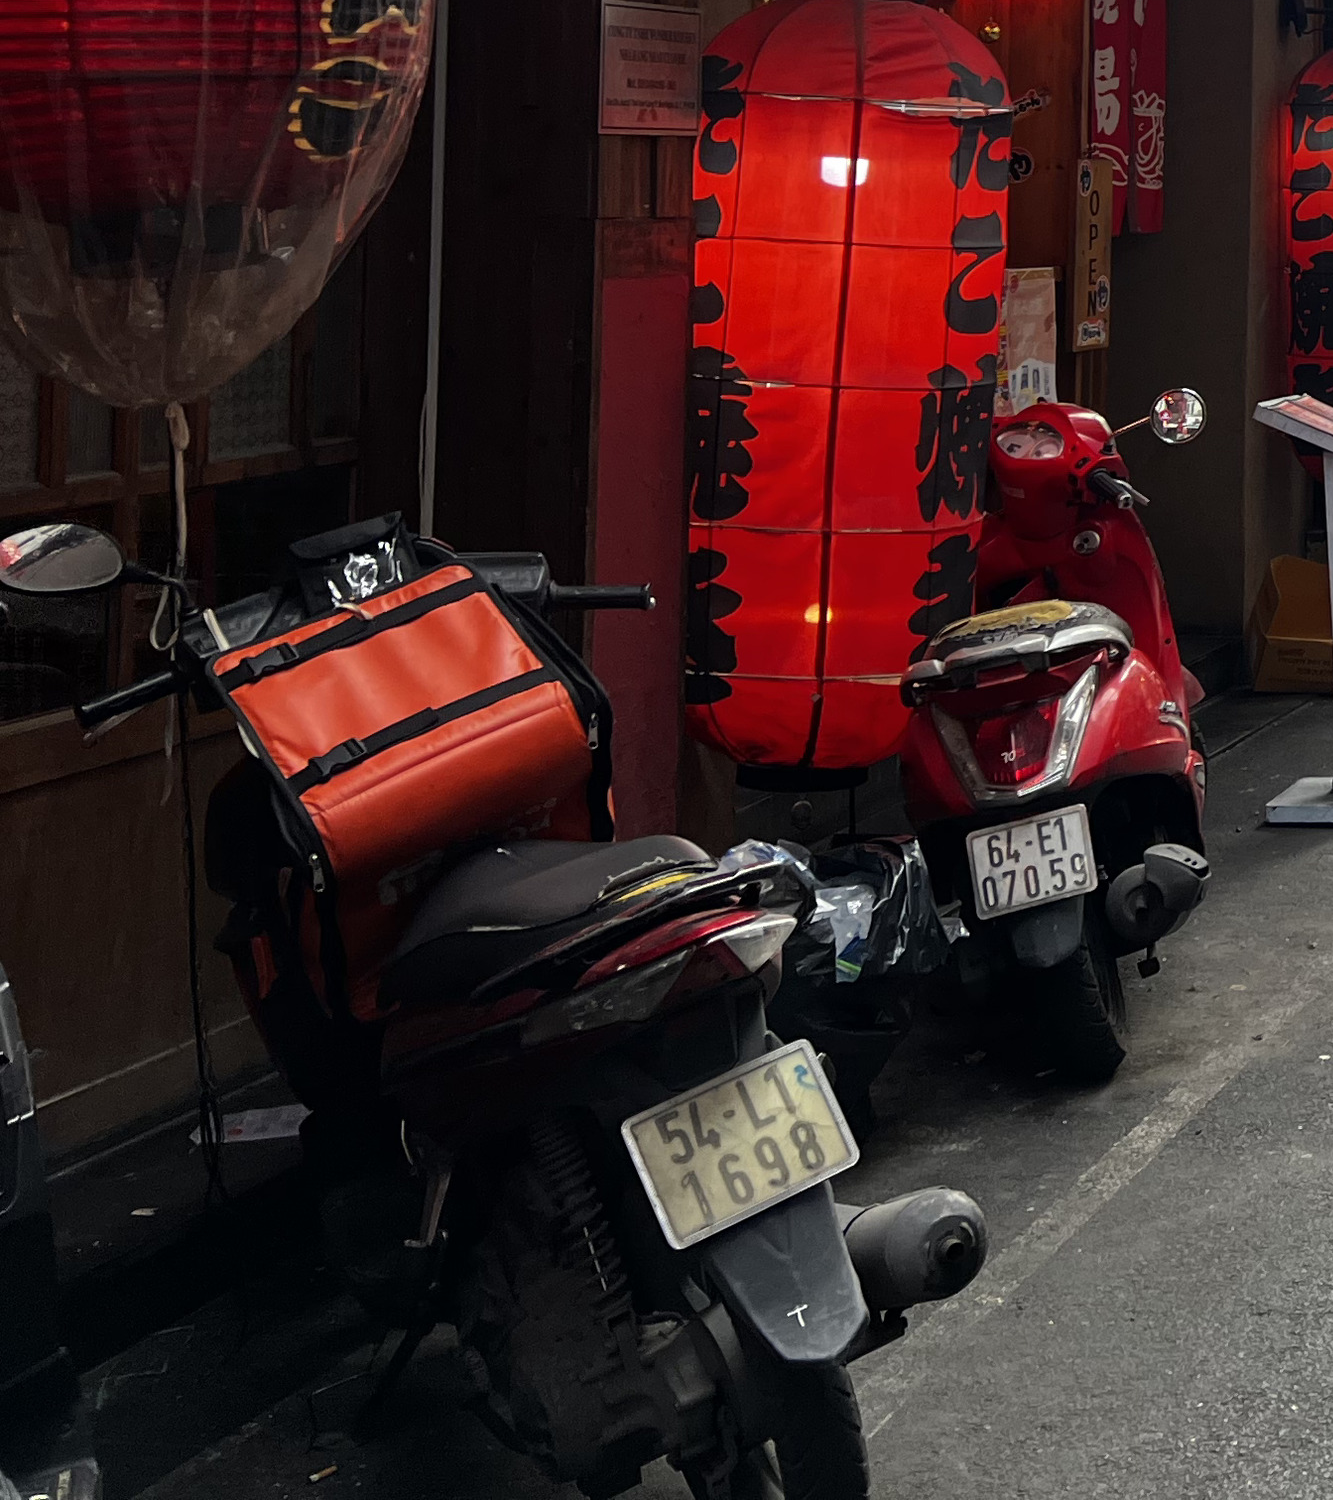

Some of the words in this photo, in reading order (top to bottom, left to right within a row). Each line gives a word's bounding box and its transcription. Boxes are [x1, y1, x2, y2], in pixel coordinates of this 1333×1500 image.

[1087, 189, 1100, 318] OPEN
[980, 854, 1089, 908] 070.59
[985, 825, 1070, 870] 64-E1
[657, 1066, 805, 1166] 54-L1
[679, 1120, 826, 1228] 1698
